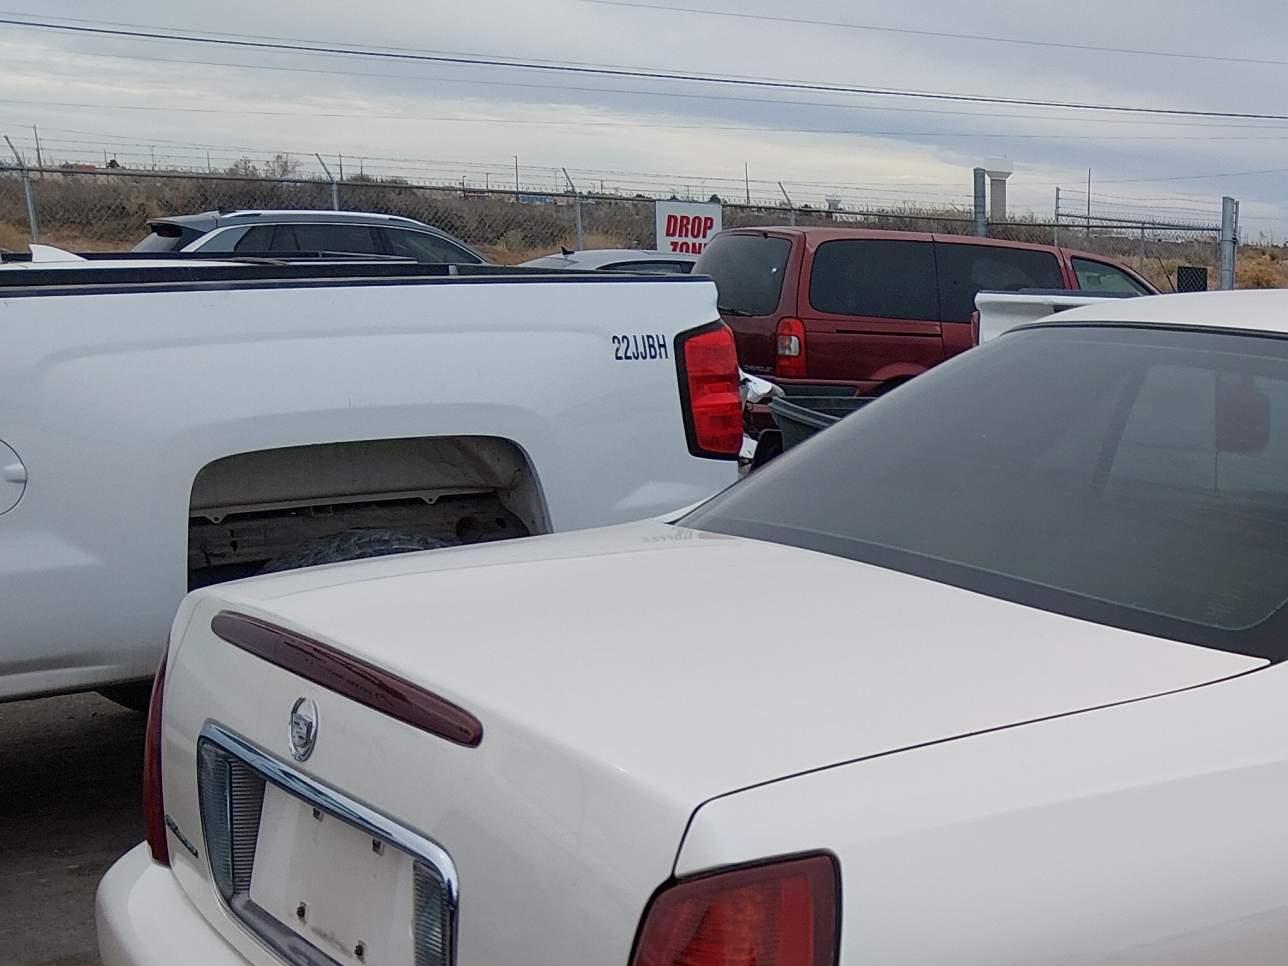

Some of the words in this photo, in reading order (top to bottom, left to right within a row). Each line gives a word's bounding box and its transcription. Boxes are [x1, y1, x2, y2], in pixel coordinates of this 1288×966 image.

[665, 214, 714, 239] DROP
[670, 241, 708, 255] ZON
[612, 334, 669, 361] 22JJBH
